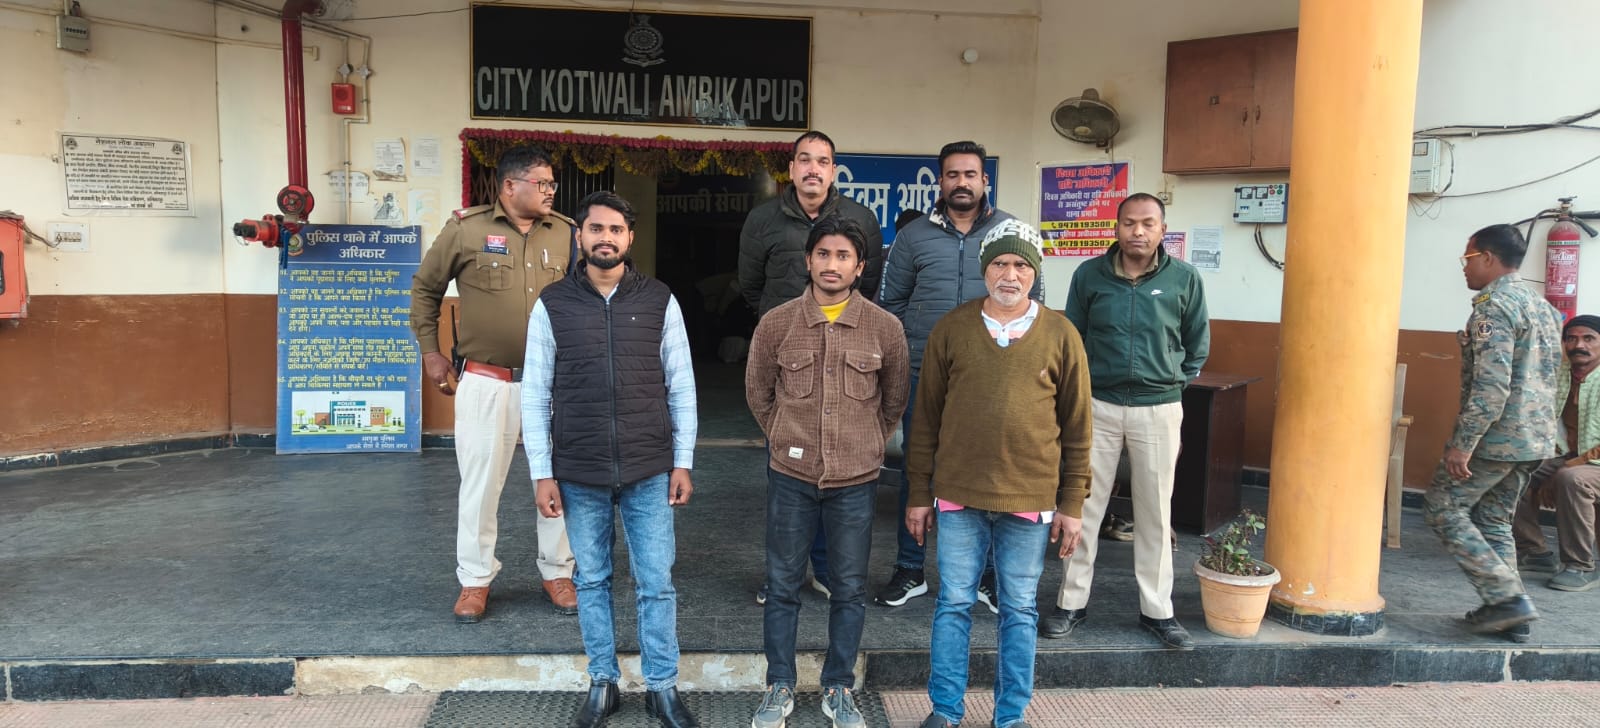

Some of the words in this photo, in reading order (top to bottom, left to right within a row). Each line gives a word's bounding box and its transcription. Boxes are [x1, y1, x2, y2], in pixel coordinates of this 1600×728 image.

[477, 66, 533, 112] CITY
[540, 68, 650, 117] KOTWALI
[658, 74, 805, 122] AMBIKAPUR
[657, 187, 712, 213] आपकी
[306, 230, 340, 246] पुलिस
[343, 231, 366, 244] थाने
[369, 230, 381, 244] में
[382, 232, 417, 244] आपके
[339, 246, 387, 259] अधिकार
